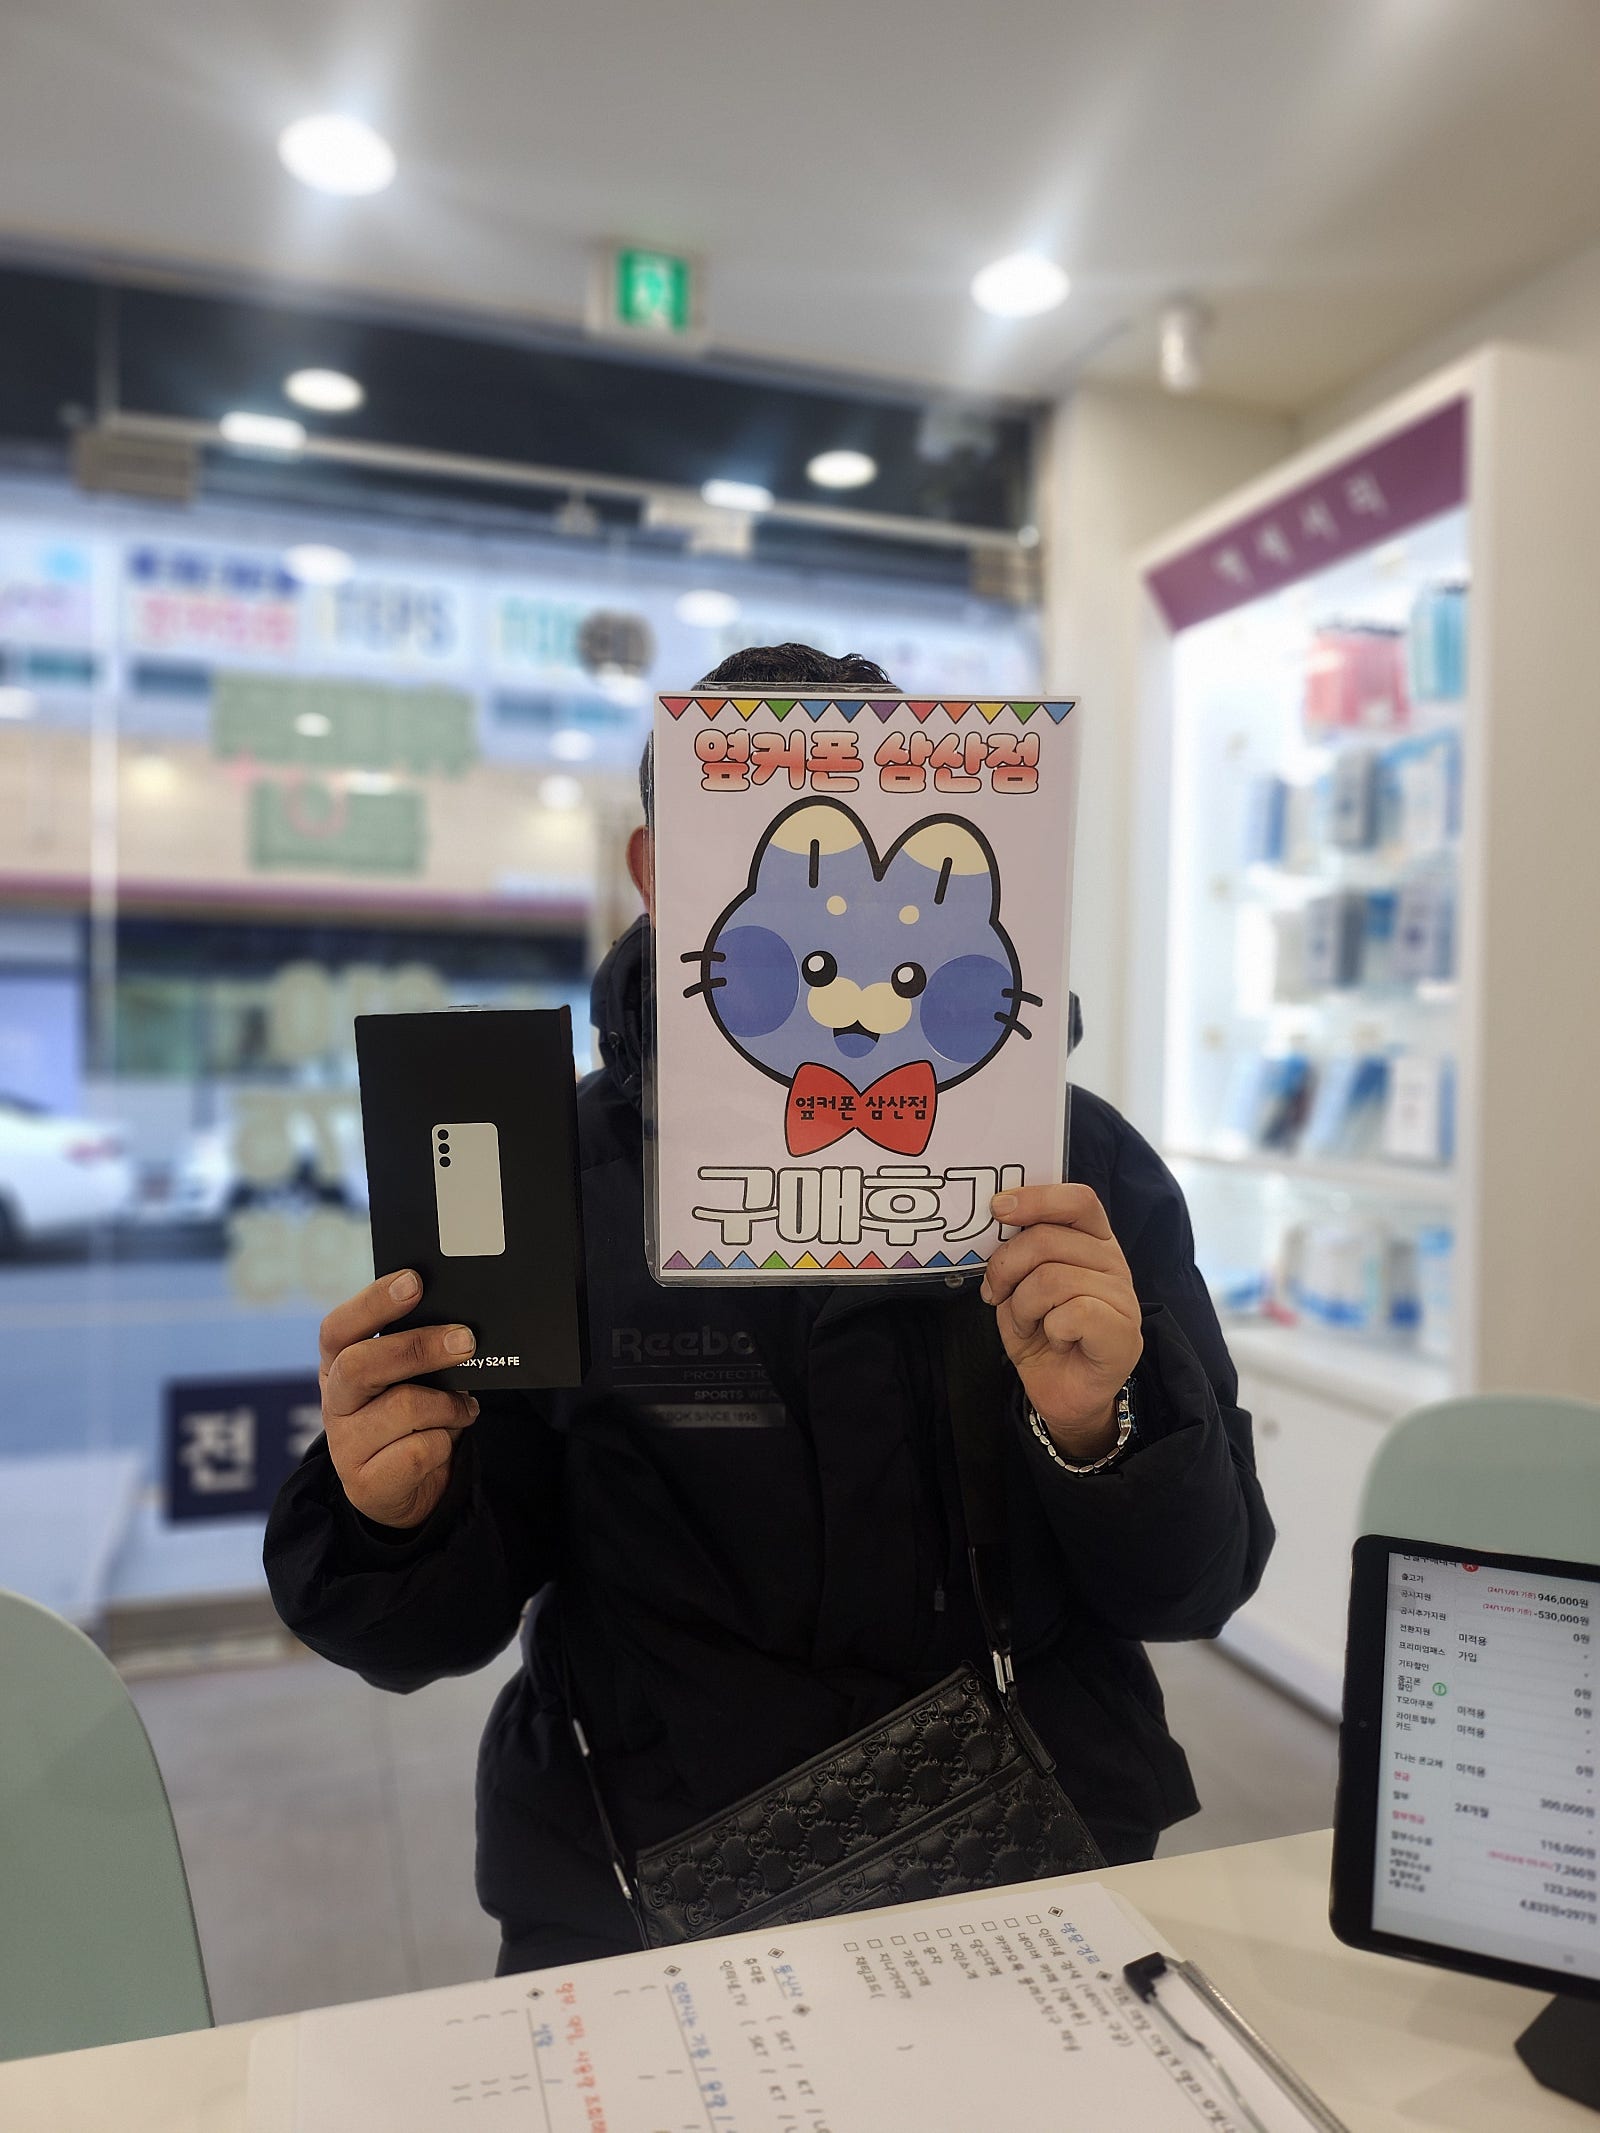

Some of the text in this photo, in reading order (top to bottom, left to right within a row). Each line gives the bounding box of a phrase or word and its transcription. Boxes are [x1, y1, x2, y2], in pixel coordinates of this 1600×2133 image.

[694, 728, 1040, 795] 옆커폰 삼산점
[795, 1095, 928, 1121] 옆커폰 삼산점
[692, 1164, 1025, 1247] 구매후기
[486, 1357, 506, 1367] S24
[508, 1357, 520, 1367] FE
[694, 1389, 744, 1401] SPORTS
[1538, 1592, 1589, 1609] 946,000원
[1458, 1632, 1488, 1647] 미적용
[1458, 1651, 1478, 1663] 가입
[923, 1947, 943, 1964] 문자
[1018, 1932, 1043, 1959] 네이버
[1039, 1928, 1066, 1957] 인터넷
[950, 1942, 980, 1979] 지인소개
[969, 1939, 1003, 1976] 당근마켓
